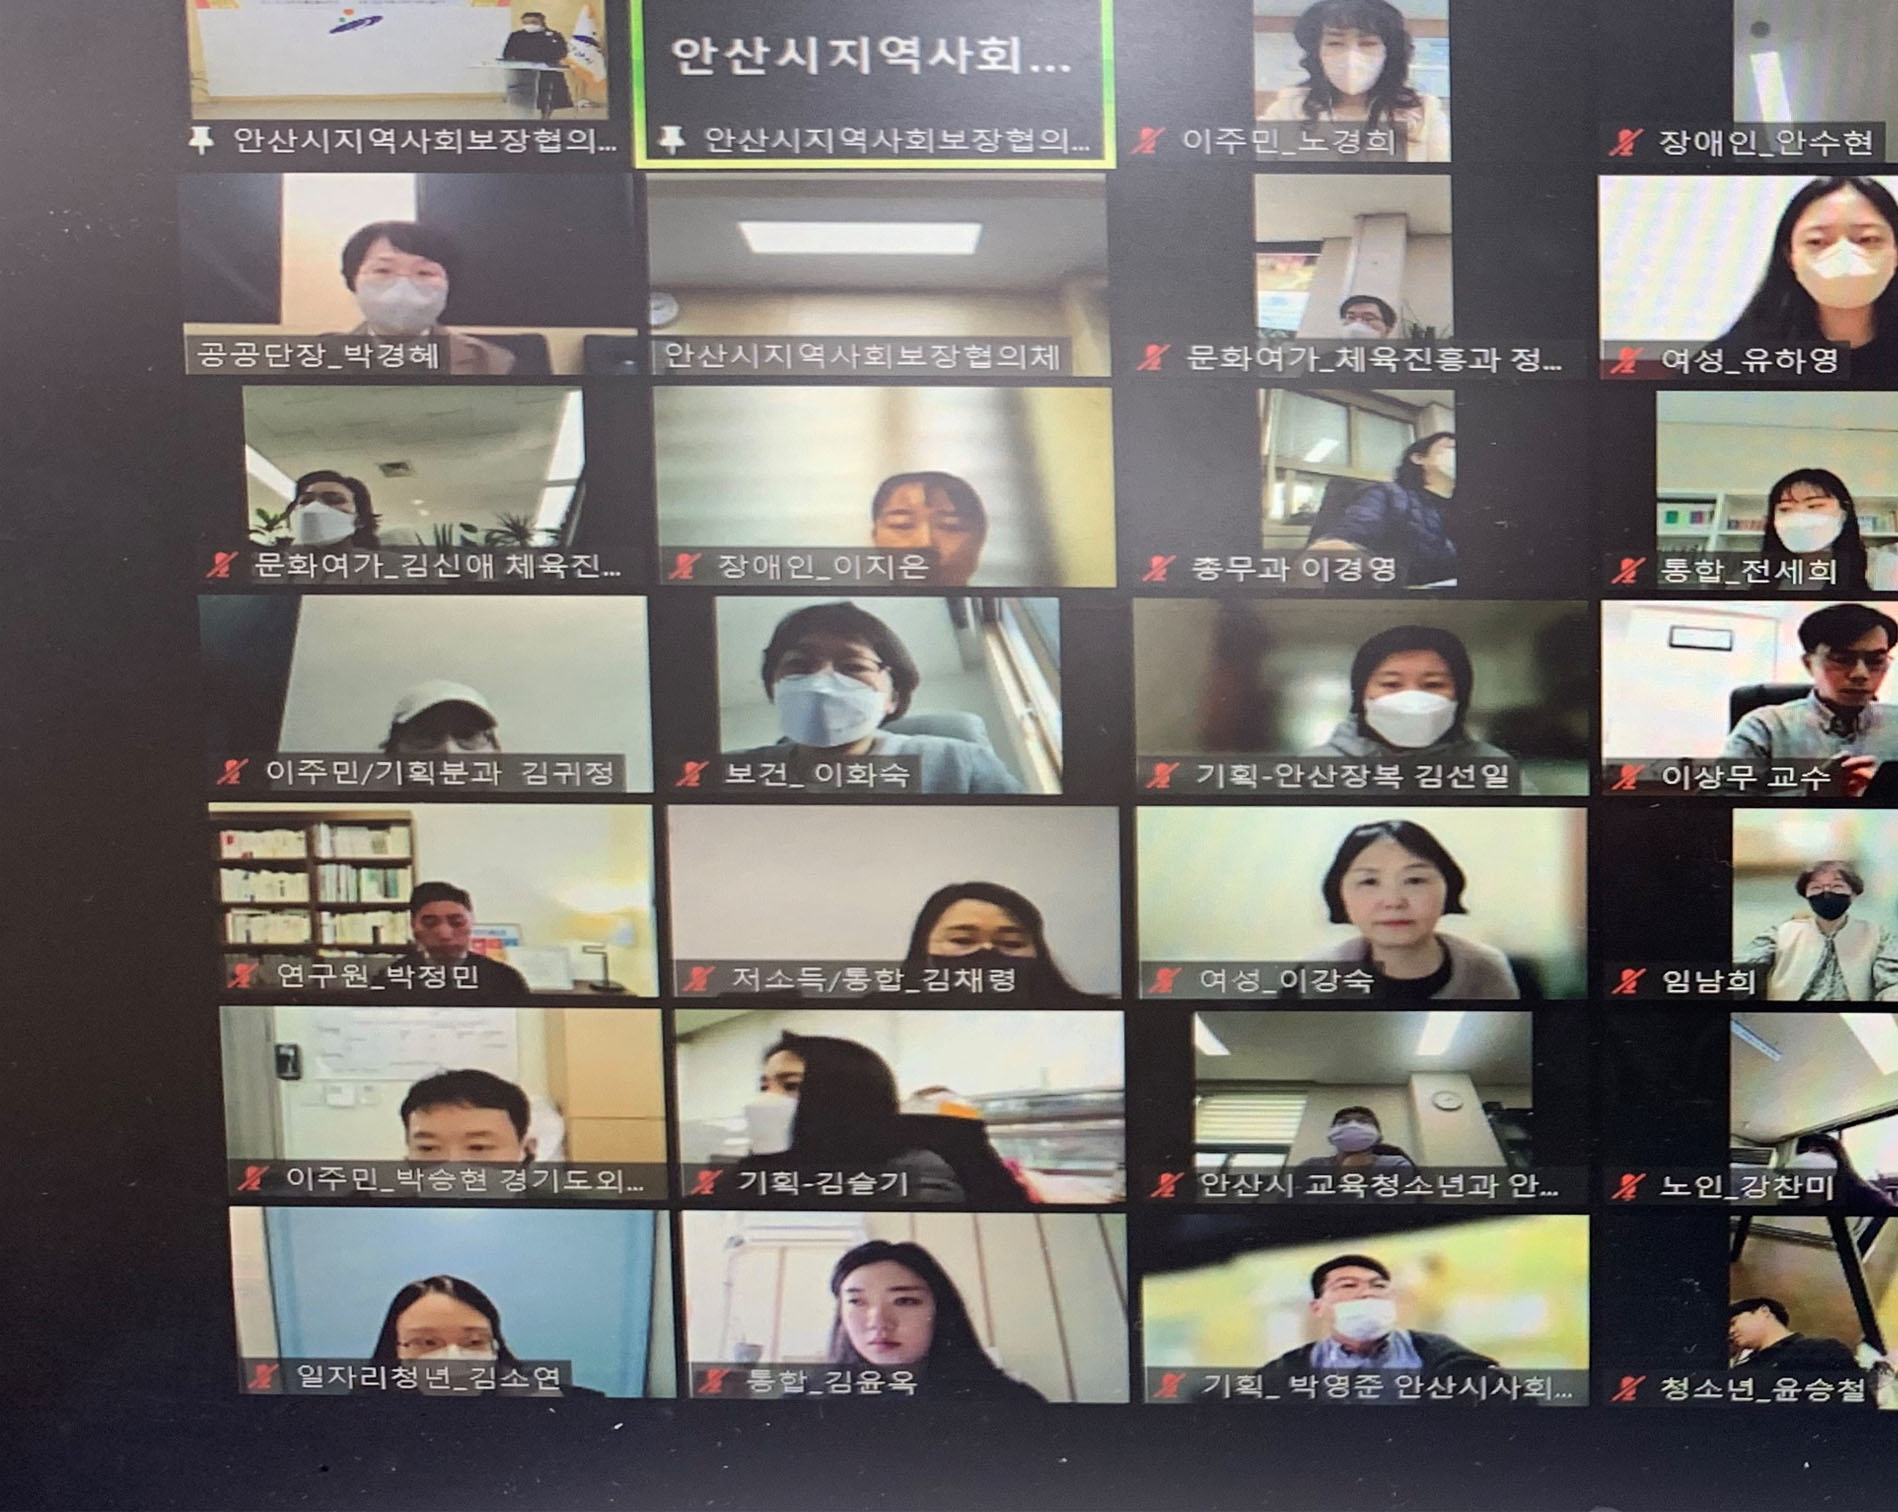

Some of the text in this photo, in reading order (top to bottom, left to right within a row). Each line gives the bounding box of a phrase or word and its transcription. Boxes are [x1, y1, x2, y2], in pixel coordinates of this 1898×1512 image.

[670, 35, 1072, 78] 안산시지역사회...
[234, 124, 617, 156] 안산시지역사회보장협의...
[705, 125, 1091, 155] 안산시지역사회보장협의...
[1182, 126, 1396, 157] 이주민_노경희
[1660, 128, 1873, 158] 장애인_안수현
[197, 340, 439, 370] 공공단장_박경혜
[665, 341, 1060, 371] 안산시지역사회보장협의체
[1188, 344, 1501, 375] 문화여가_체육진흥과
[1661, 345, 1839, 375] 여성_유하영
[254, 552, 621, 582] 문화여가_김신애 체육진...
[719, 553, 930, 582] 장애인_이지은
[1302, 557, 1398, 584] 이경영
[1661, 558, 1838, 587] 통합_전세희
[267, 758, 615, 789] 이주민/기획분과 김귀정
[815, 762, 911, 790] 이화숙
[1196, 762, 1510, 792] 기획-안산장복 김선일
[1662, 764, 1831, 791] 이상무 교수
[276, 960, 479, 990] 연구원_박정민
[732, 966, 1016, 995] 저소득/통합_김채령
[1200, 967, 1375, 995] 여성_이강숙
[1663, 969, 1757, 996] 임남희
[286, 1163, 488, 1197] 이주민_박승현
[738, 1167, 910, 1198] 기획-김슬기
[1200, 1172, 1296, 1200] 안산시
[1304, 1171, 1500, 1200] 교육청소년과
[1661, 1173, 1834, 1203] 노인_강찬미
[296, 1362, 562, 1392] 일자리청년_김소연
[746, 1368, 918, 1398] 통합_김윤옥
[1289, 1373, 1384, 1400] 박영준
[1393, 1373, 1573, 1400] 안산시사회...
[1661, 1374, 1866, 1404] 청소년_윤승철
